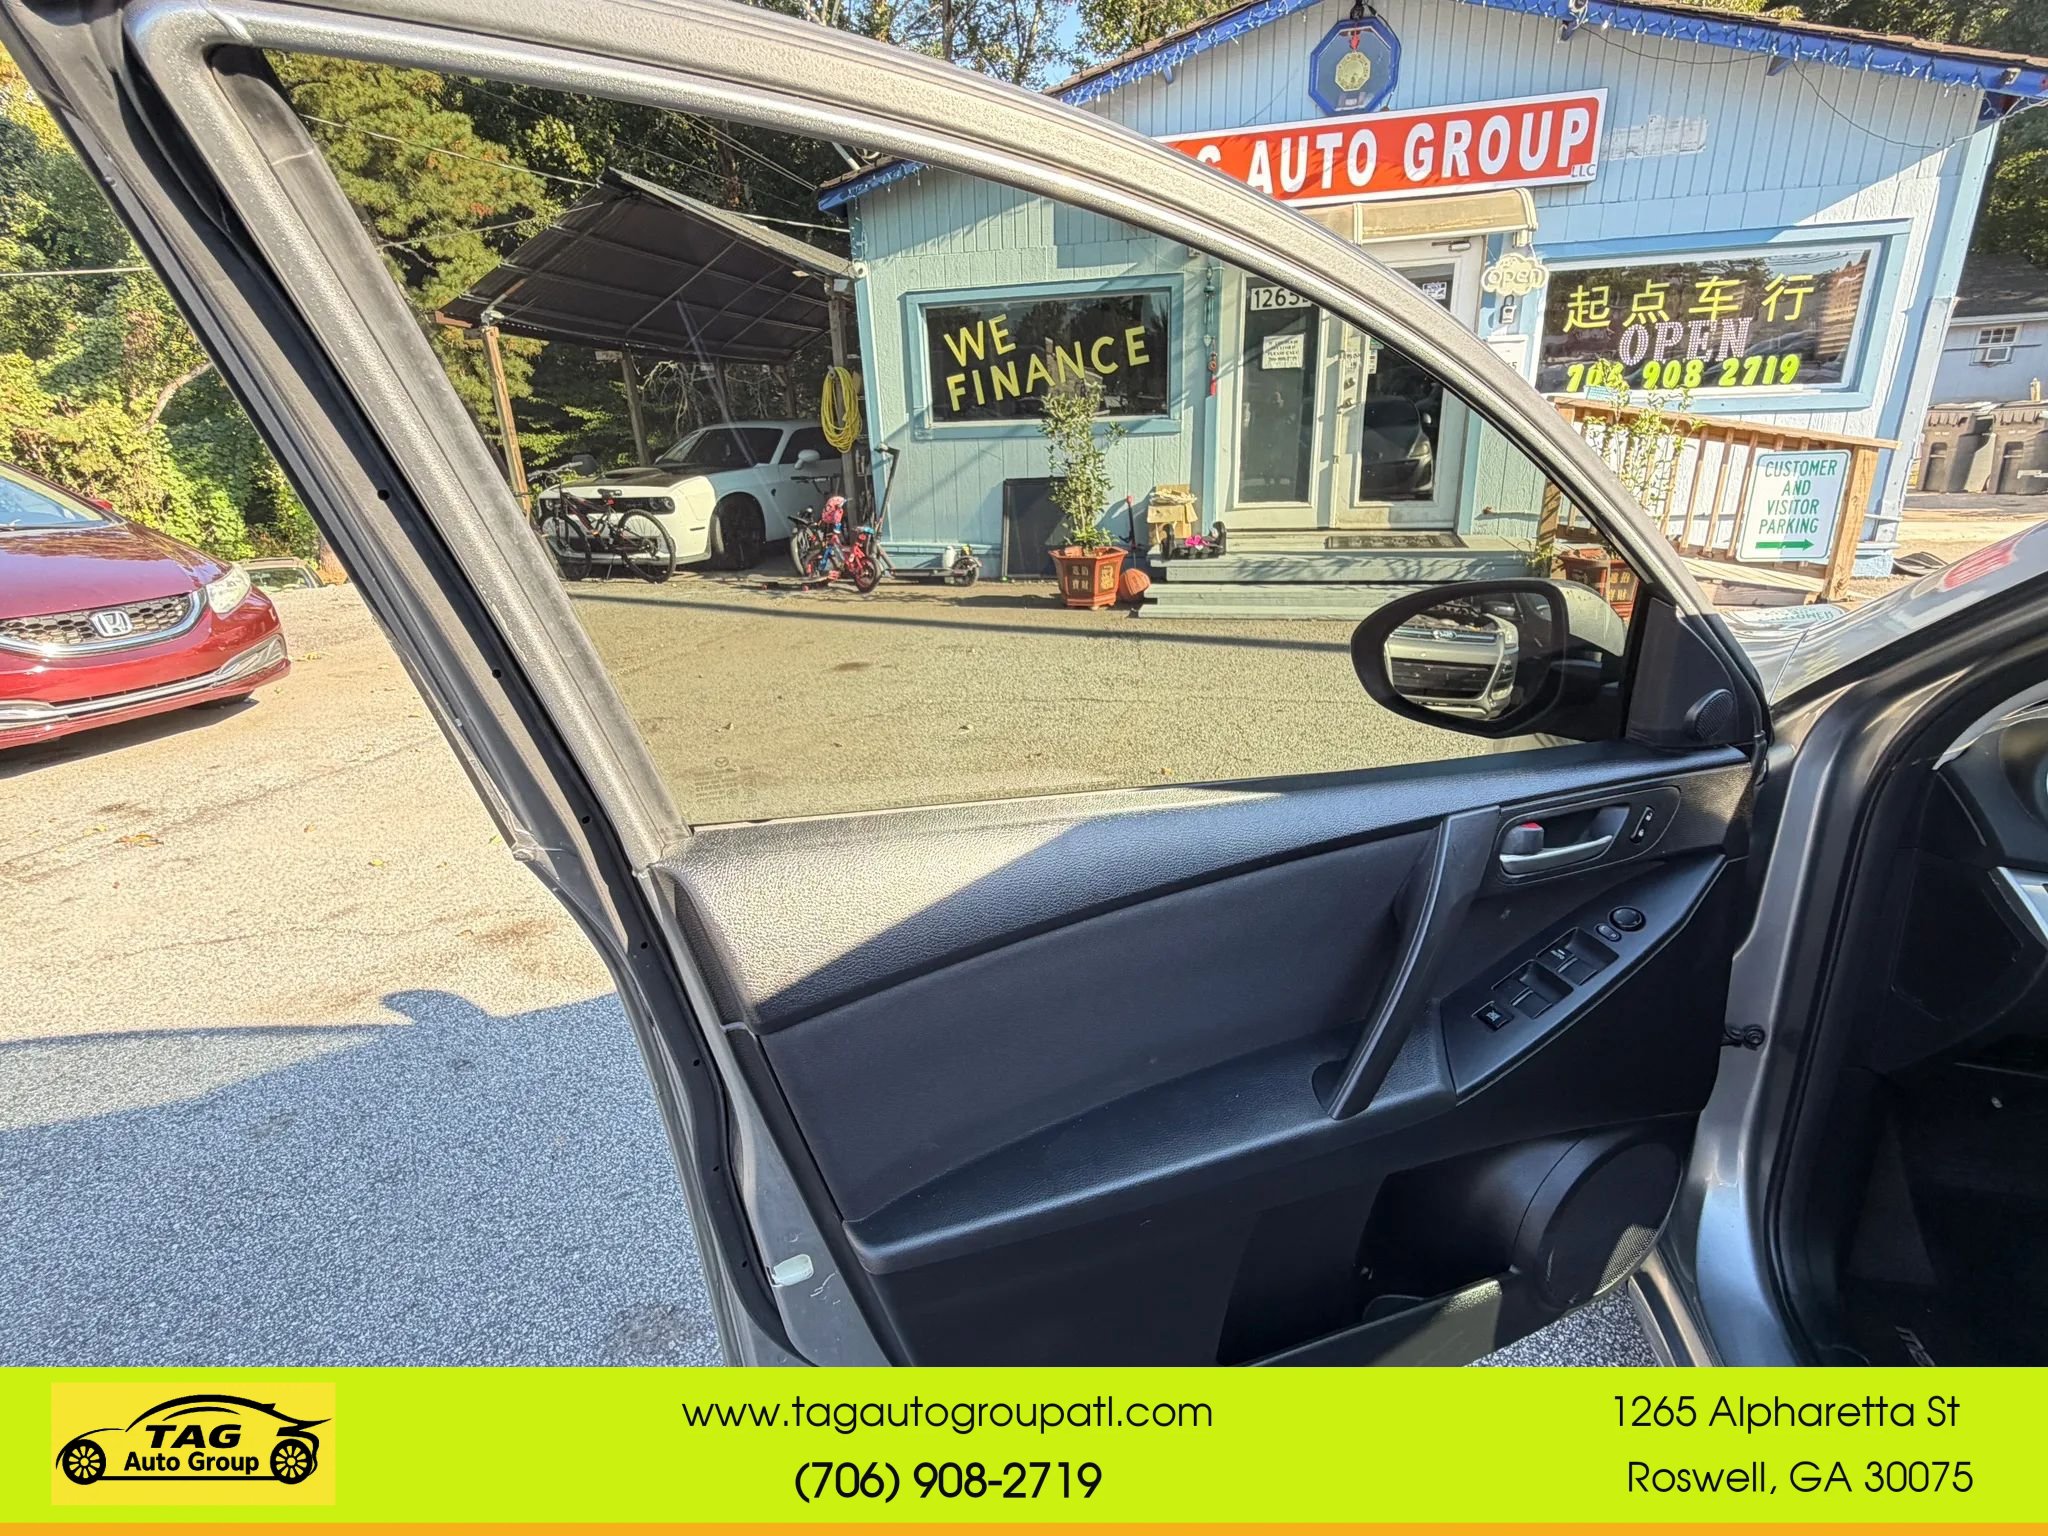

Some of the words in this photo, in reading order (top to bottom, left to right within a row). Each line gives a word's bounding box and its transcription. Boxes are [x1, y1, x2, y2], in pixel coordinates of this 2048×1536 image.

[1246, 128, 1377, 195] AUTO
[1404, 107, 1591, 182] GROUP
[1571, 163, 1598, 180] LLC
[1563, 272, 1815, 333] 起点车行
[943, 313, 1017, 367] WE
[1619, 316, 1753, 367] OPEN
[946, 325, 1151, 412] FINANCE
[1643, 359, 1704, 389] 908
[1718, 353, 1800, 387] 2719
[1764, 459, 1838, 478] CUSTOMER
[1781, 479, 1811, 497] AND
[1758, 517, 1820, 535] PARKING
[1767, 499, 1820, 516] VISITOR
